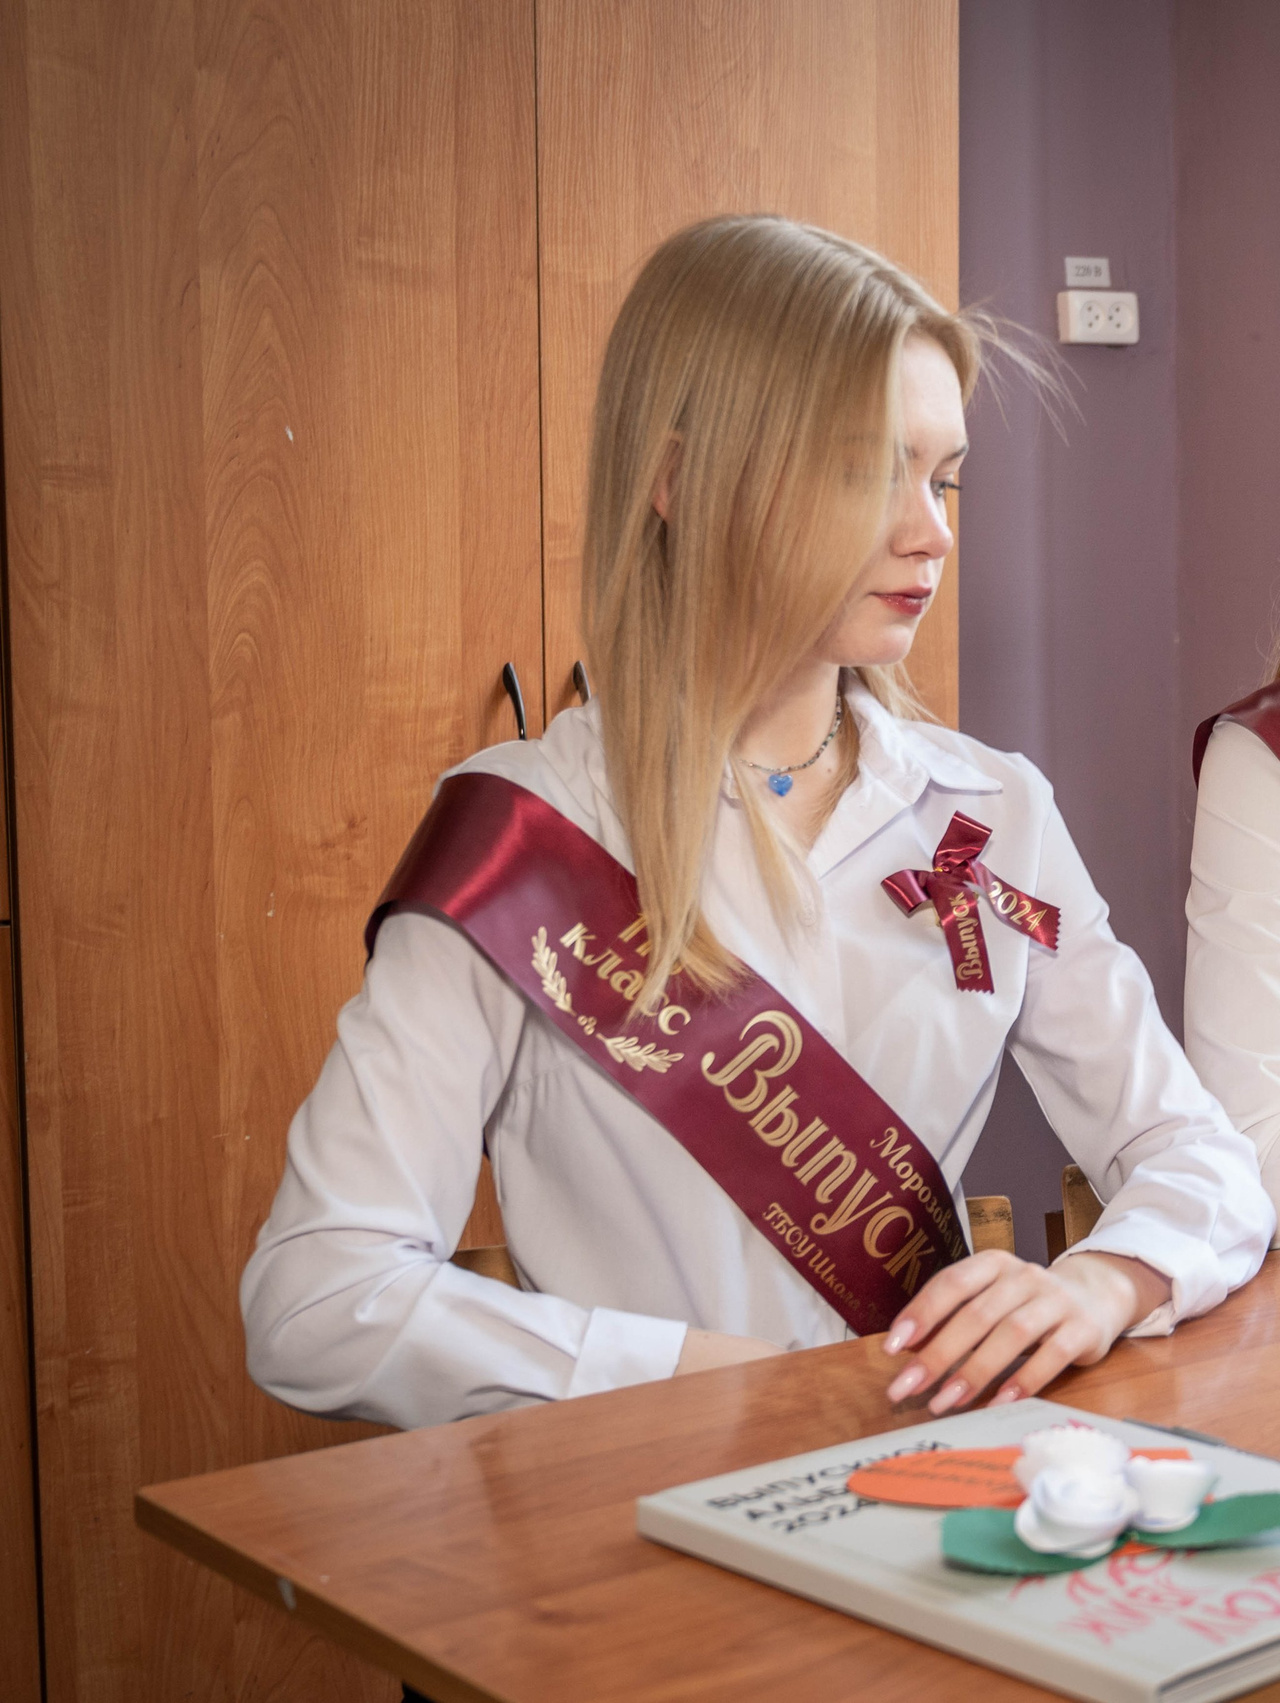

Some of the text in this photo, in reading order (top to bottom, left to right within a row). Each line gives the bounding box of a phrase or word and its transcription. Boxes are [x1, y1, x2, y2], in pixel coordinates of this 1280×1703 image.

[955, 891, 984, 981] Выпуск
[987, 881, 1048, 932] 2024
[701, 1010, 935, 1297] Выпуск
[762, 1202, 809, 1259] ГБОУ
